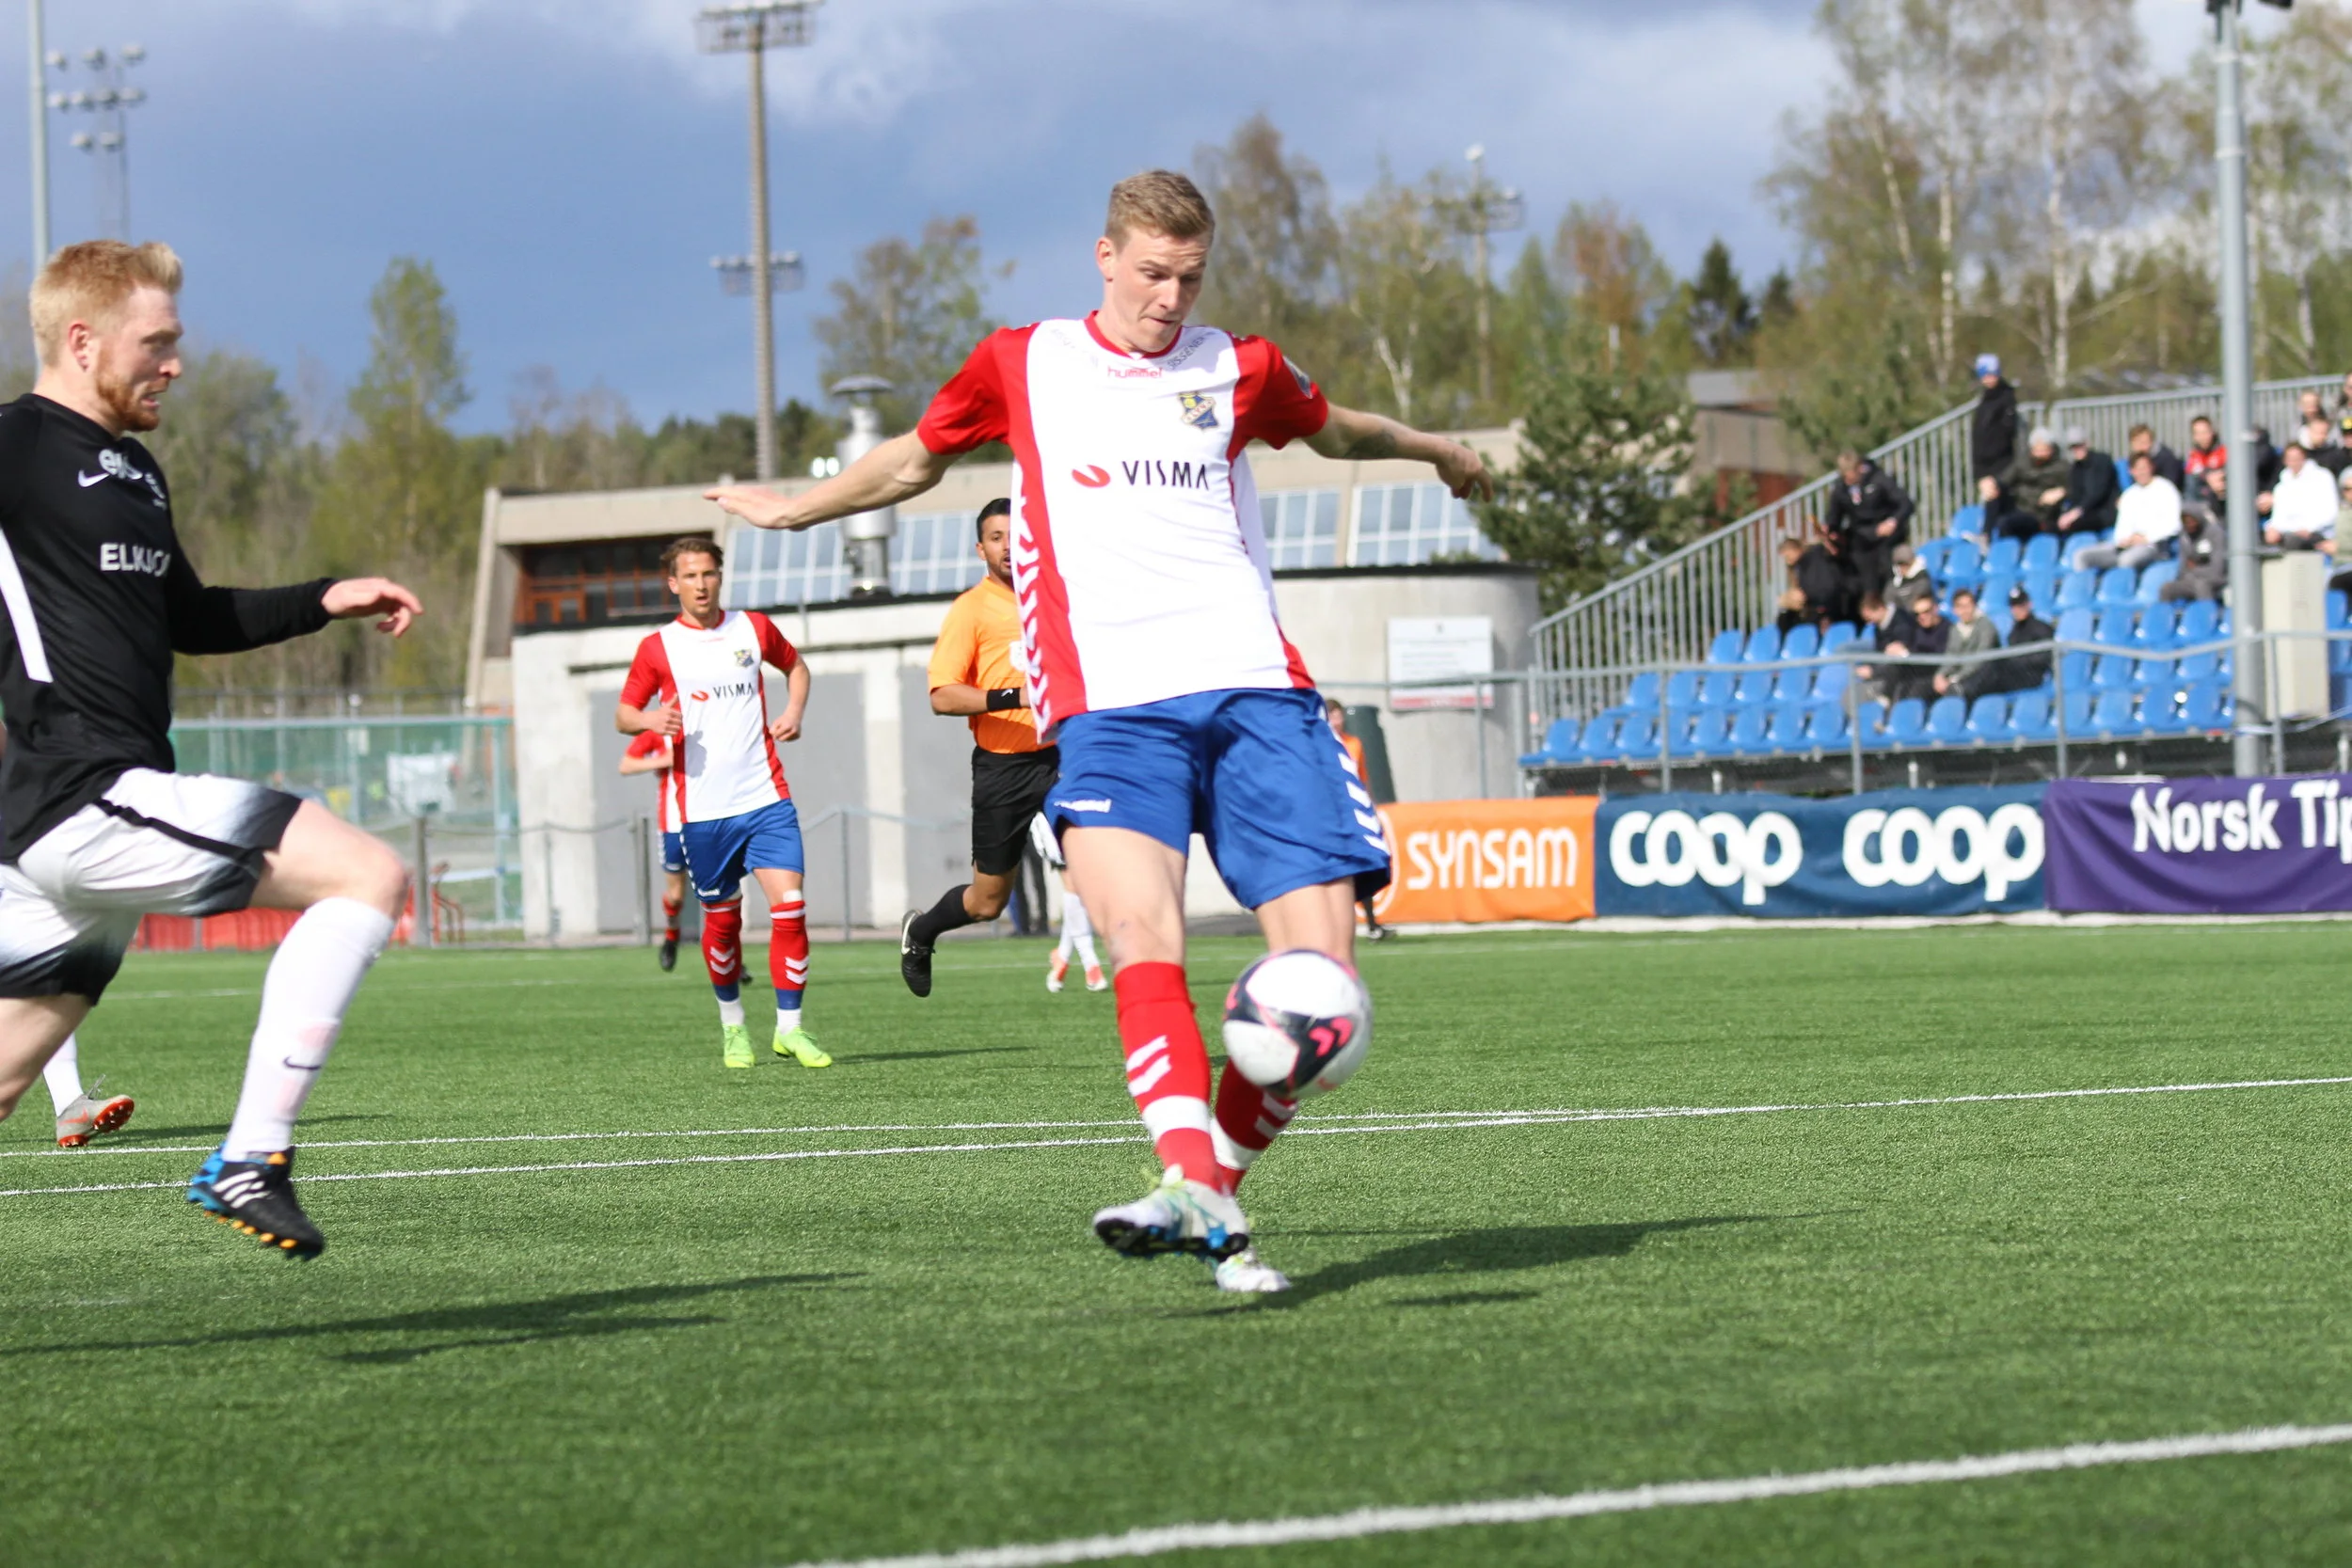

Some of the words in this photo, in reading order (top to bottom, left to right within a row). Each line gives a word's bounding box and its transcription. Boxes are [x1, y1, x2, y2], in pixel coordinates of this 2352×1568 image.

[1107, 365, 1164, 379] hummel
[1122, 460, 1209, 490] VISMA
[712, 682, 754, 700] VISMA
[2130, 782, 2283, 853] Norsk
[1406, 827, 1578, 890] SYNSAM
[1609, 810, 1804, 906] coop
[1842, 802, 2045, 902] coop
